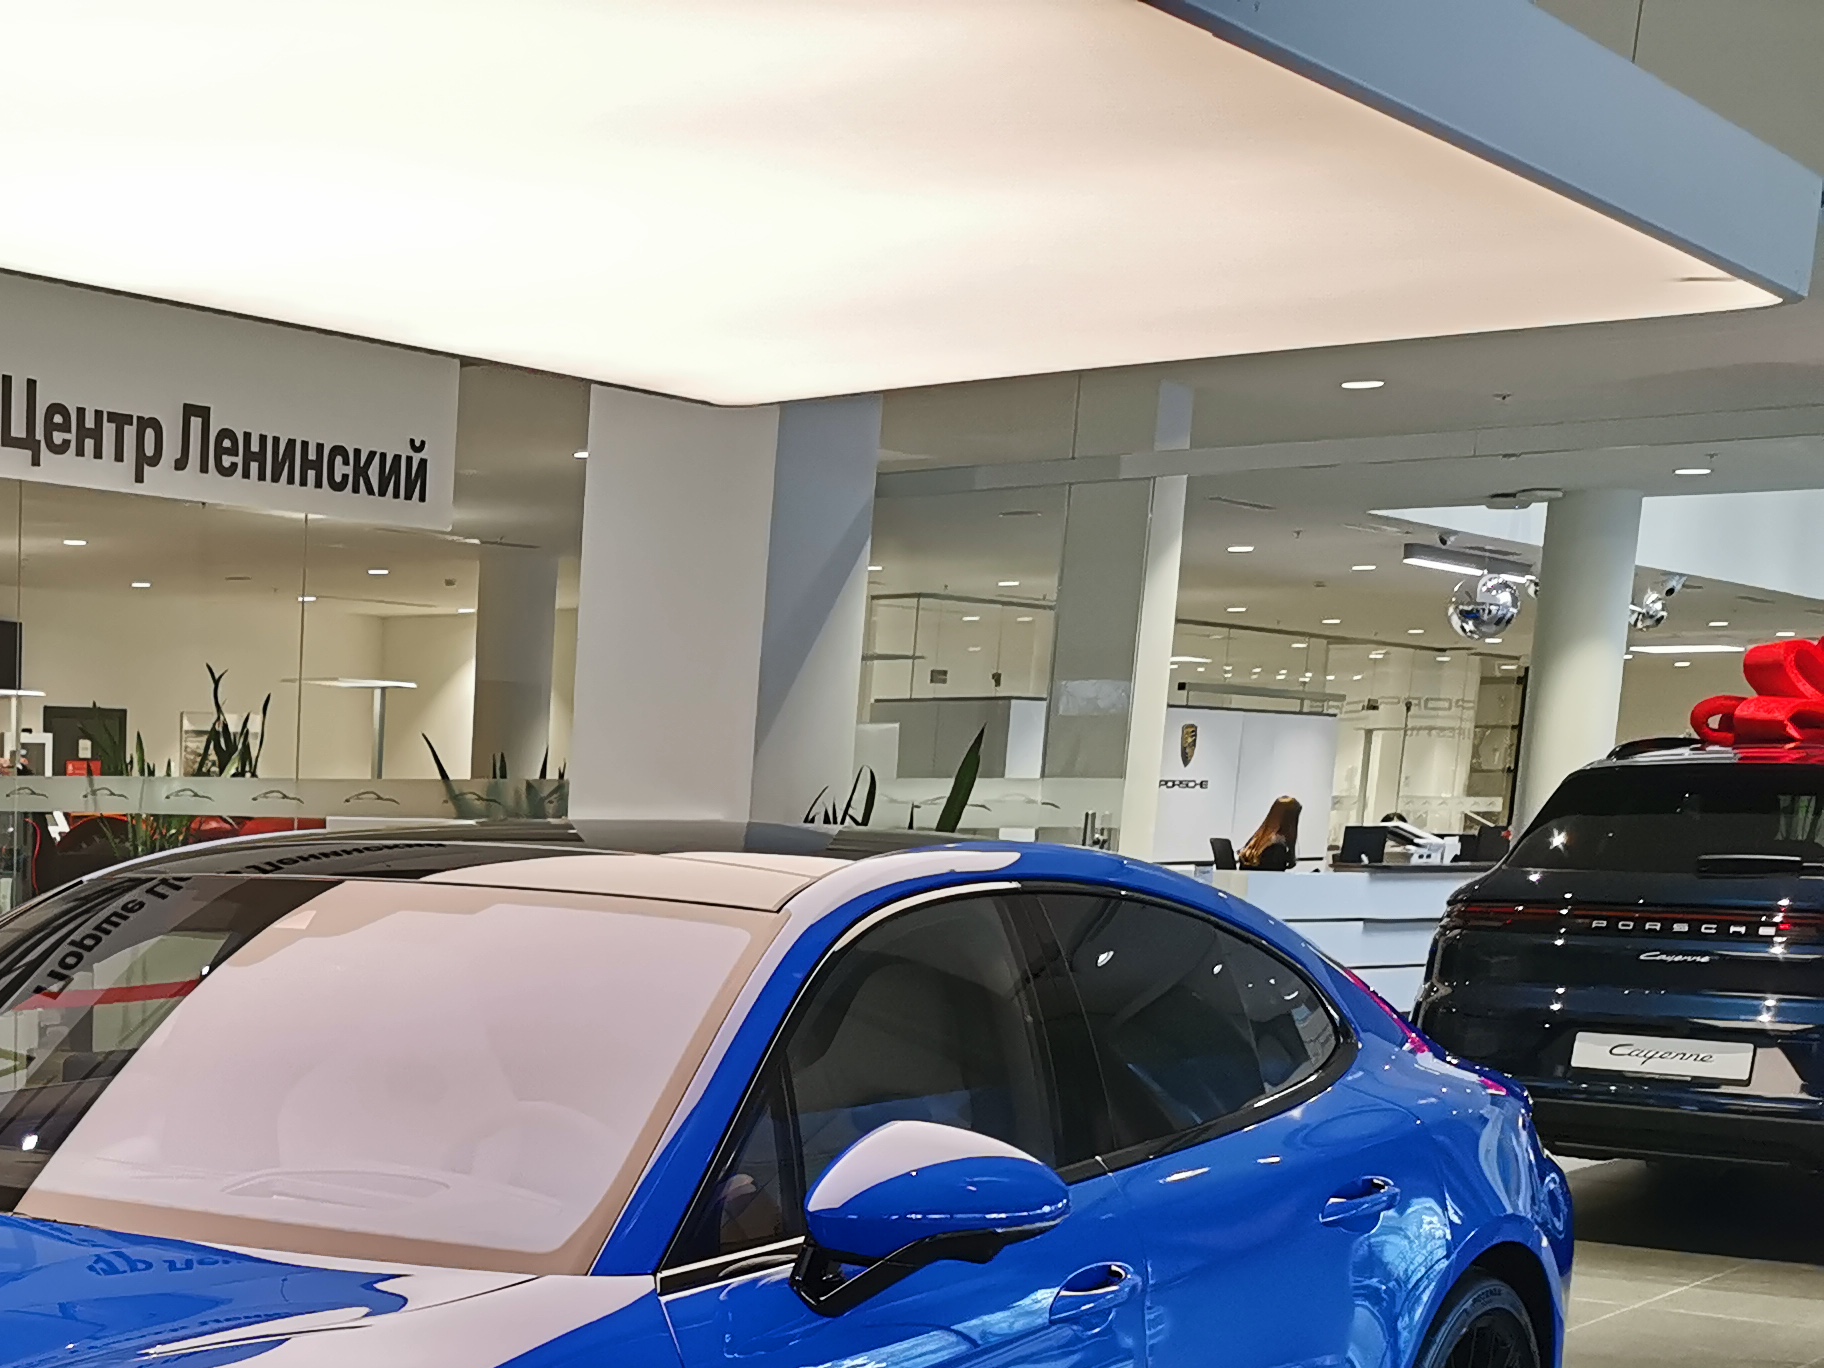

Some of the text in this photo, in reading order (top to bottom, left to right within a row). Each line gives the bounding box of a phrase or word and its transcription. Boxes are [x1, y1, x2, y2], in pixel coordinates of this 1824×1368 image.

[1, 373, 164, 483] Центр
[174, 402, 429, 503] Ленинский
[1159, 779, 1209, 789] PORSCHE
[1592, 919, 1777, 936] PORSCHE
[1639, 951, 1712, 963] Cayenne
[1609, 1043, 1715, 1066] Cayenne
